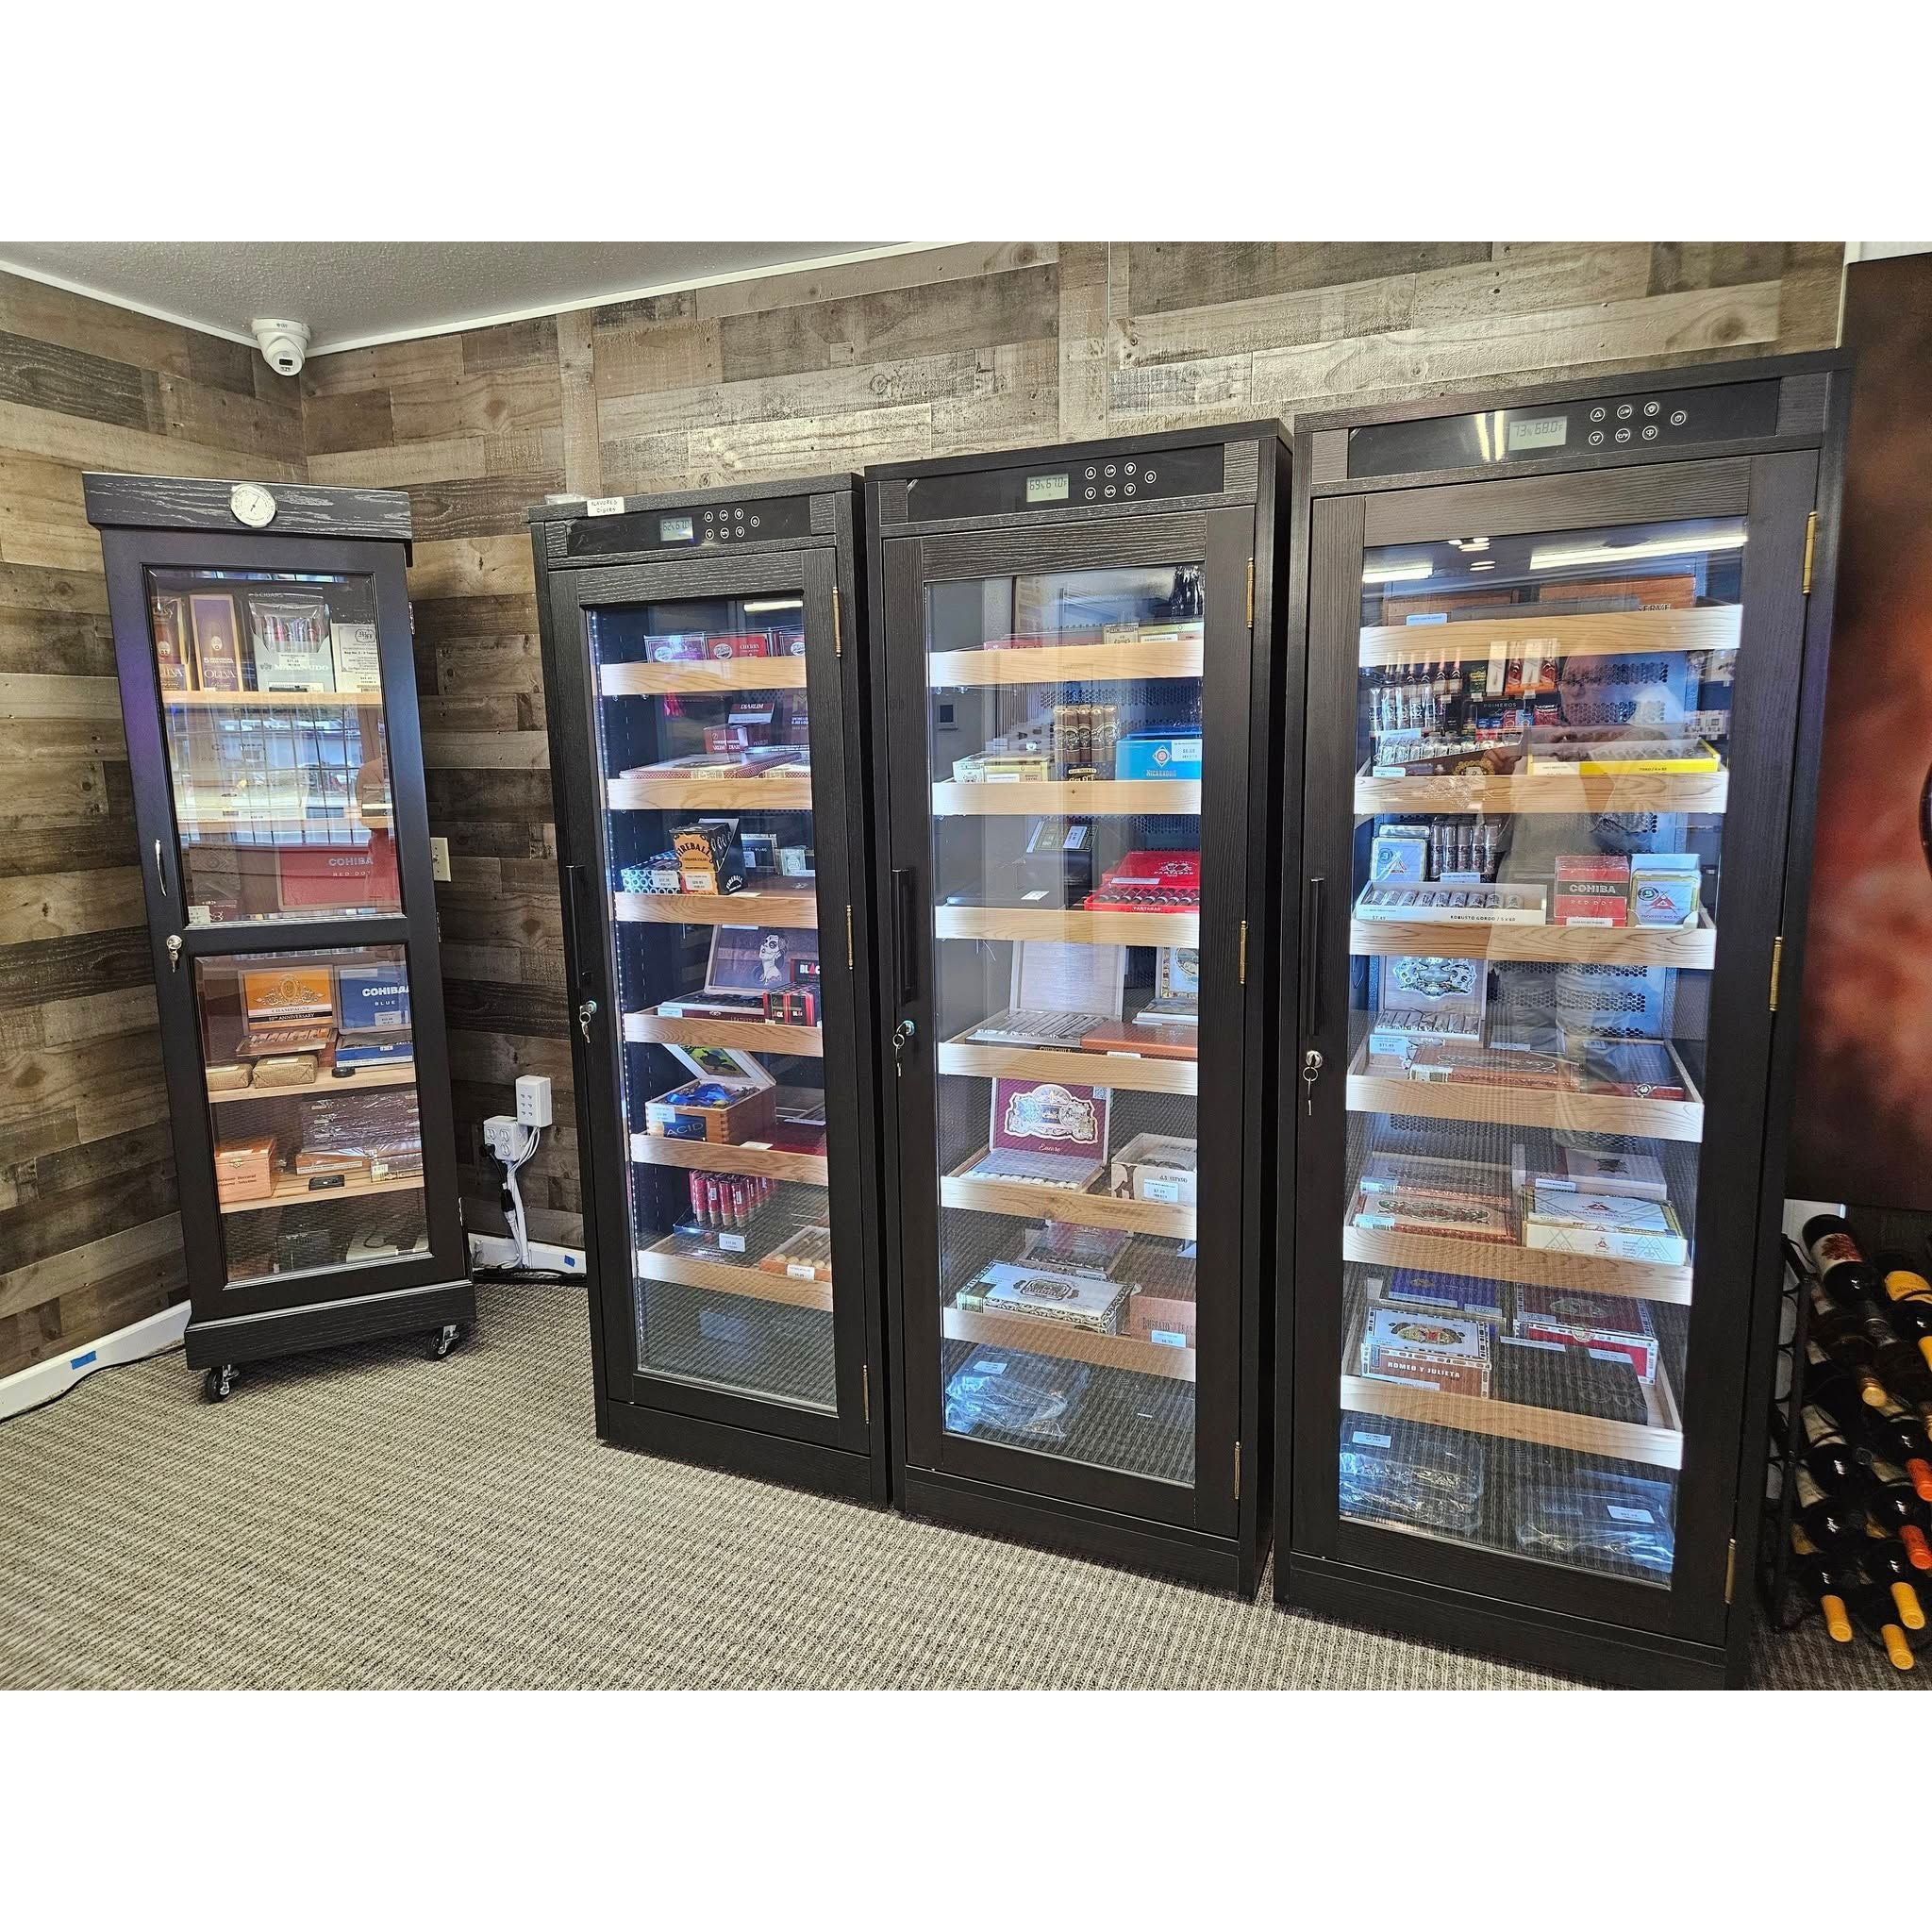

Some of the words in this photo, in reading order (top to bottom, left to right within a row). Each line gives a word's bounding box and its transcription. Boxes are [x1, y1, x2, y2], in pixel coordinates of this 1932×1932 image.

[204, 669, 237, 680] OLIVA
[675, 841, 711, 858] FIREBALL
[328, 857, 374, 867] COHIBA
[1569, 884, 1616, 894] COHIBA
[362, 986, 408, 997] COHIBA
[666, 1123, 704, 1137] ACID
[1387, 1361, 1417, 1372] ROMEO
[1426, 1368, 1460, 1378] JULIETA
